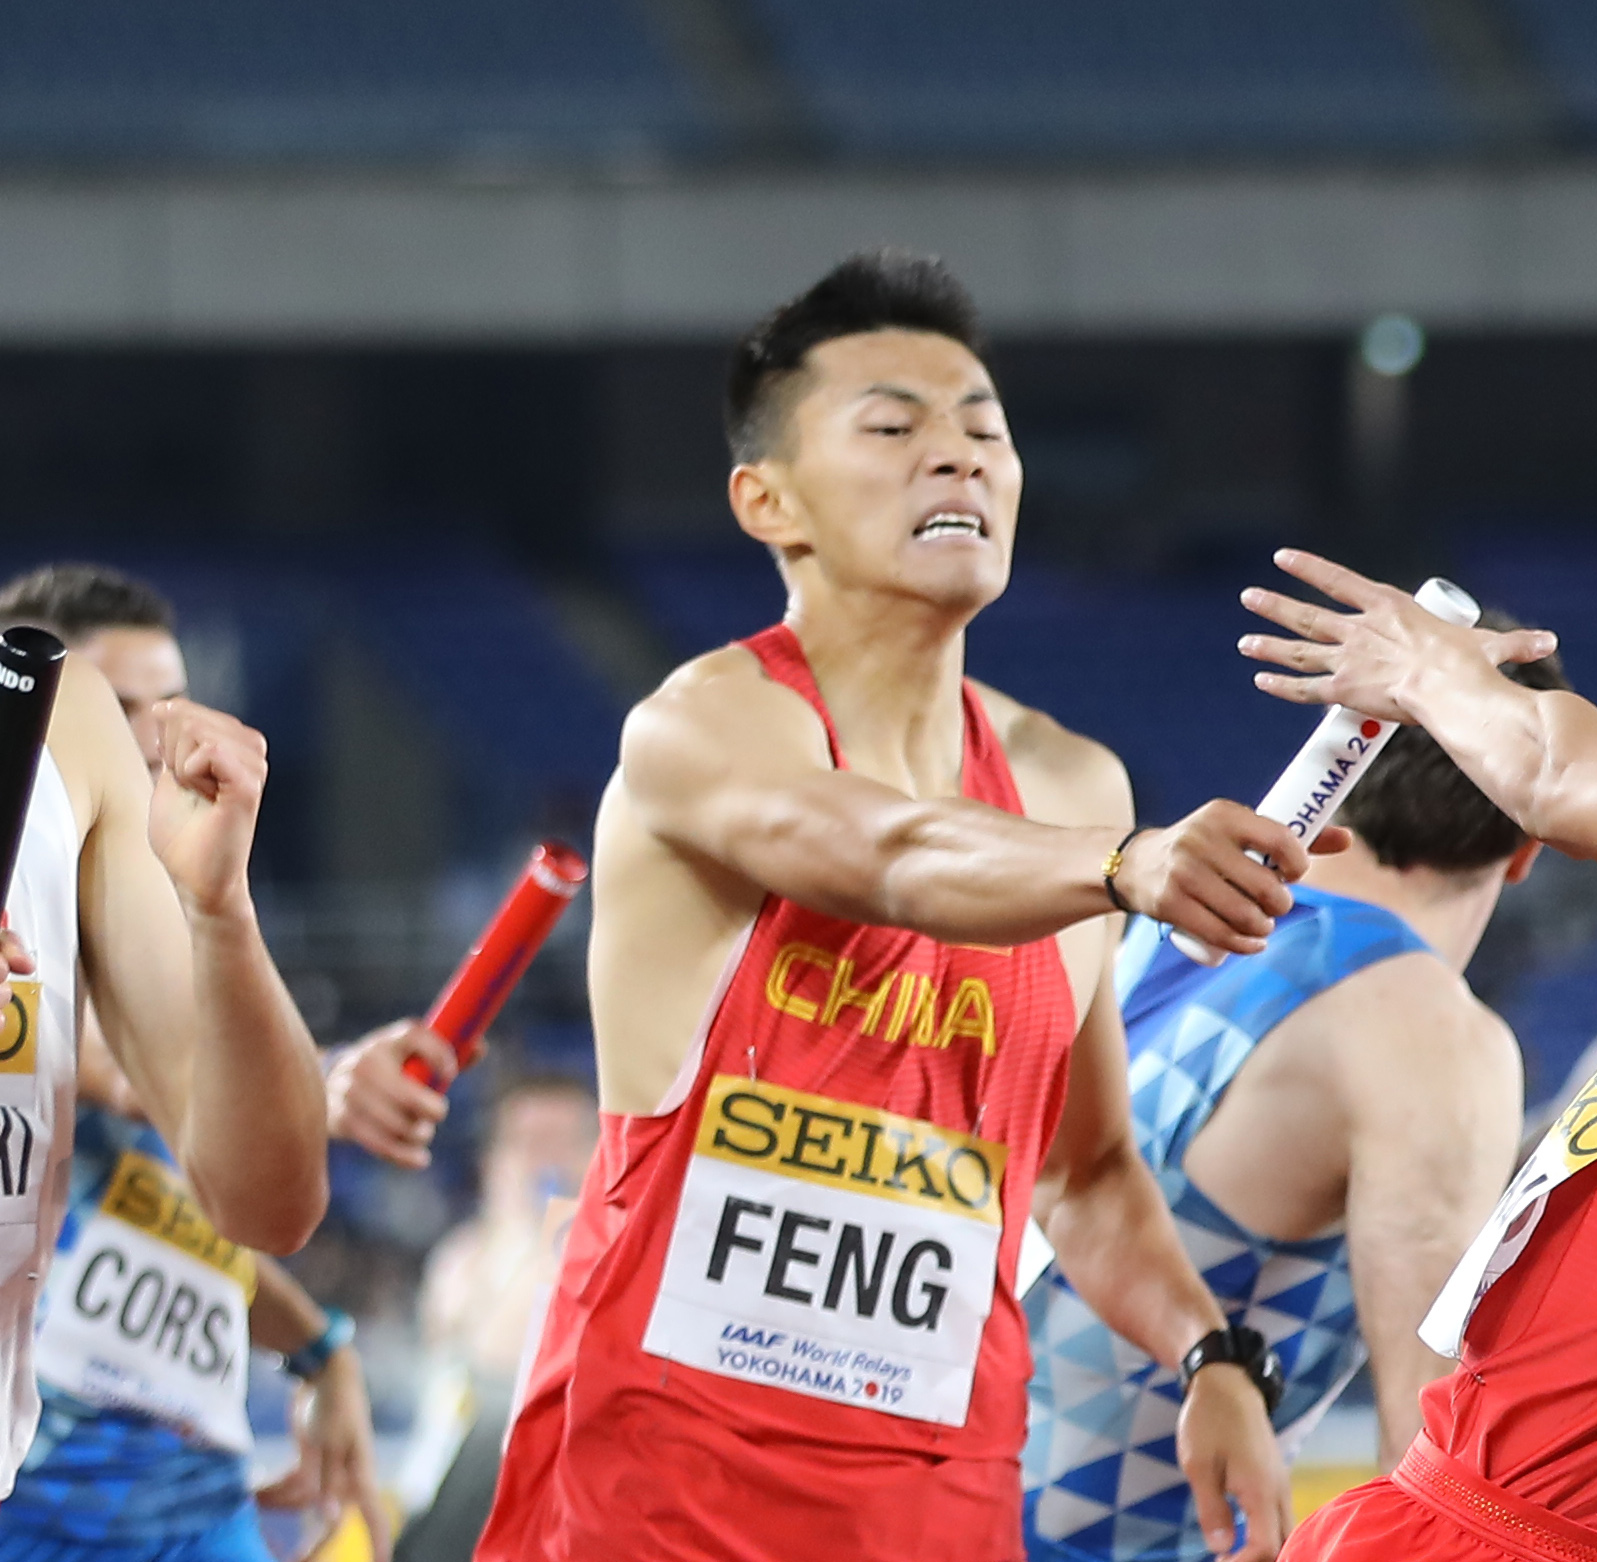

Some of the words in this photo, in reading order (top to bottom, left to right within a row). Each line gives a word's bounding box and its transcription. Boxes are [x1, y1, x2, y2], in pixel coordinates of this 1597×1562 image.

[765, 941, 996, 1057] CHINA
[713, 1091, 992, 1211] SEIKO
[75, 1248, 236, 1385] CORS
[705, 1194, 953, 1331] FENG
[717, 1346, 847, 1396] YOKOHAMA
[720, 1323, 788, 1348] IAAF
[791, 1336, 851, 1370] World
[851, 1352, 913, 1383] Relays
